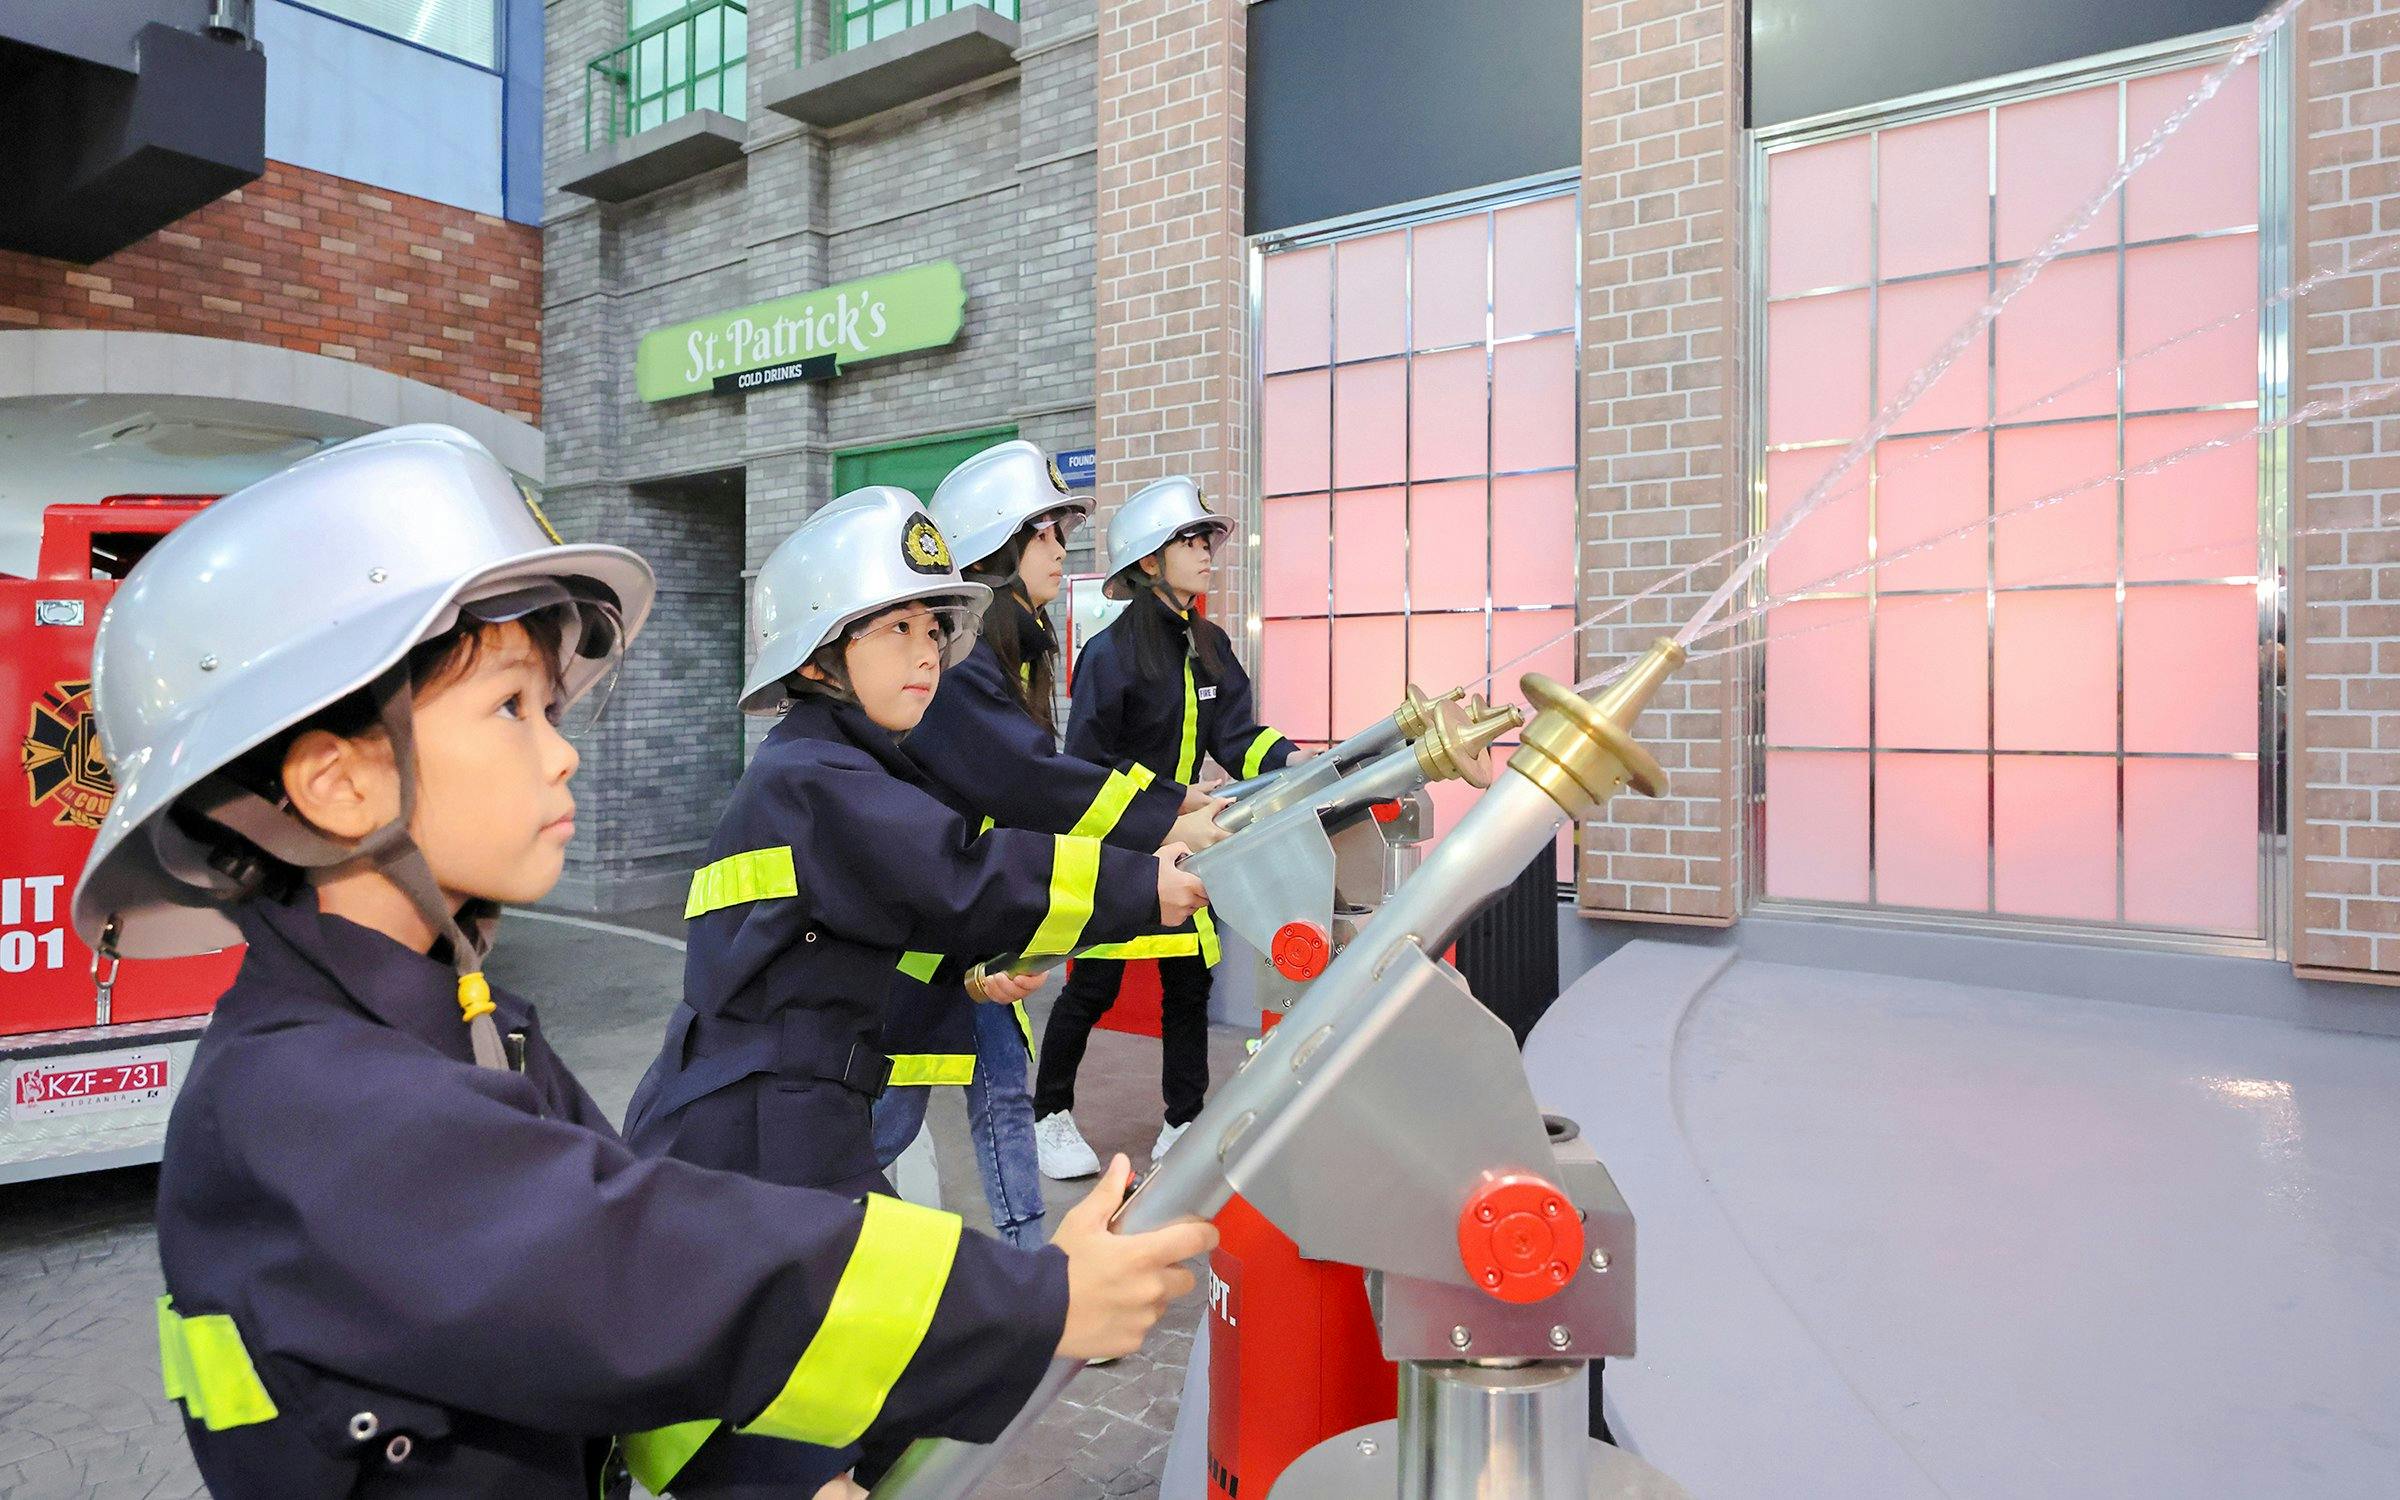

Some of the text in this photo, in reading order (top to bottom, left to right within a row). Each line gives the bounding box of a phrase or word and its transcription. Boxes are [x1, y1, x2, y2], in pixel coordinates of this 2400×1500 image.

[685, 290, 887, 382] St. Patrick's
[738, 363, 803, 388] COLD DRINKS
[1, 875, 65, 925] IT
[0, 927, 64, 973] 01
[60, 1094, 127, 1108] KIDZANIA
